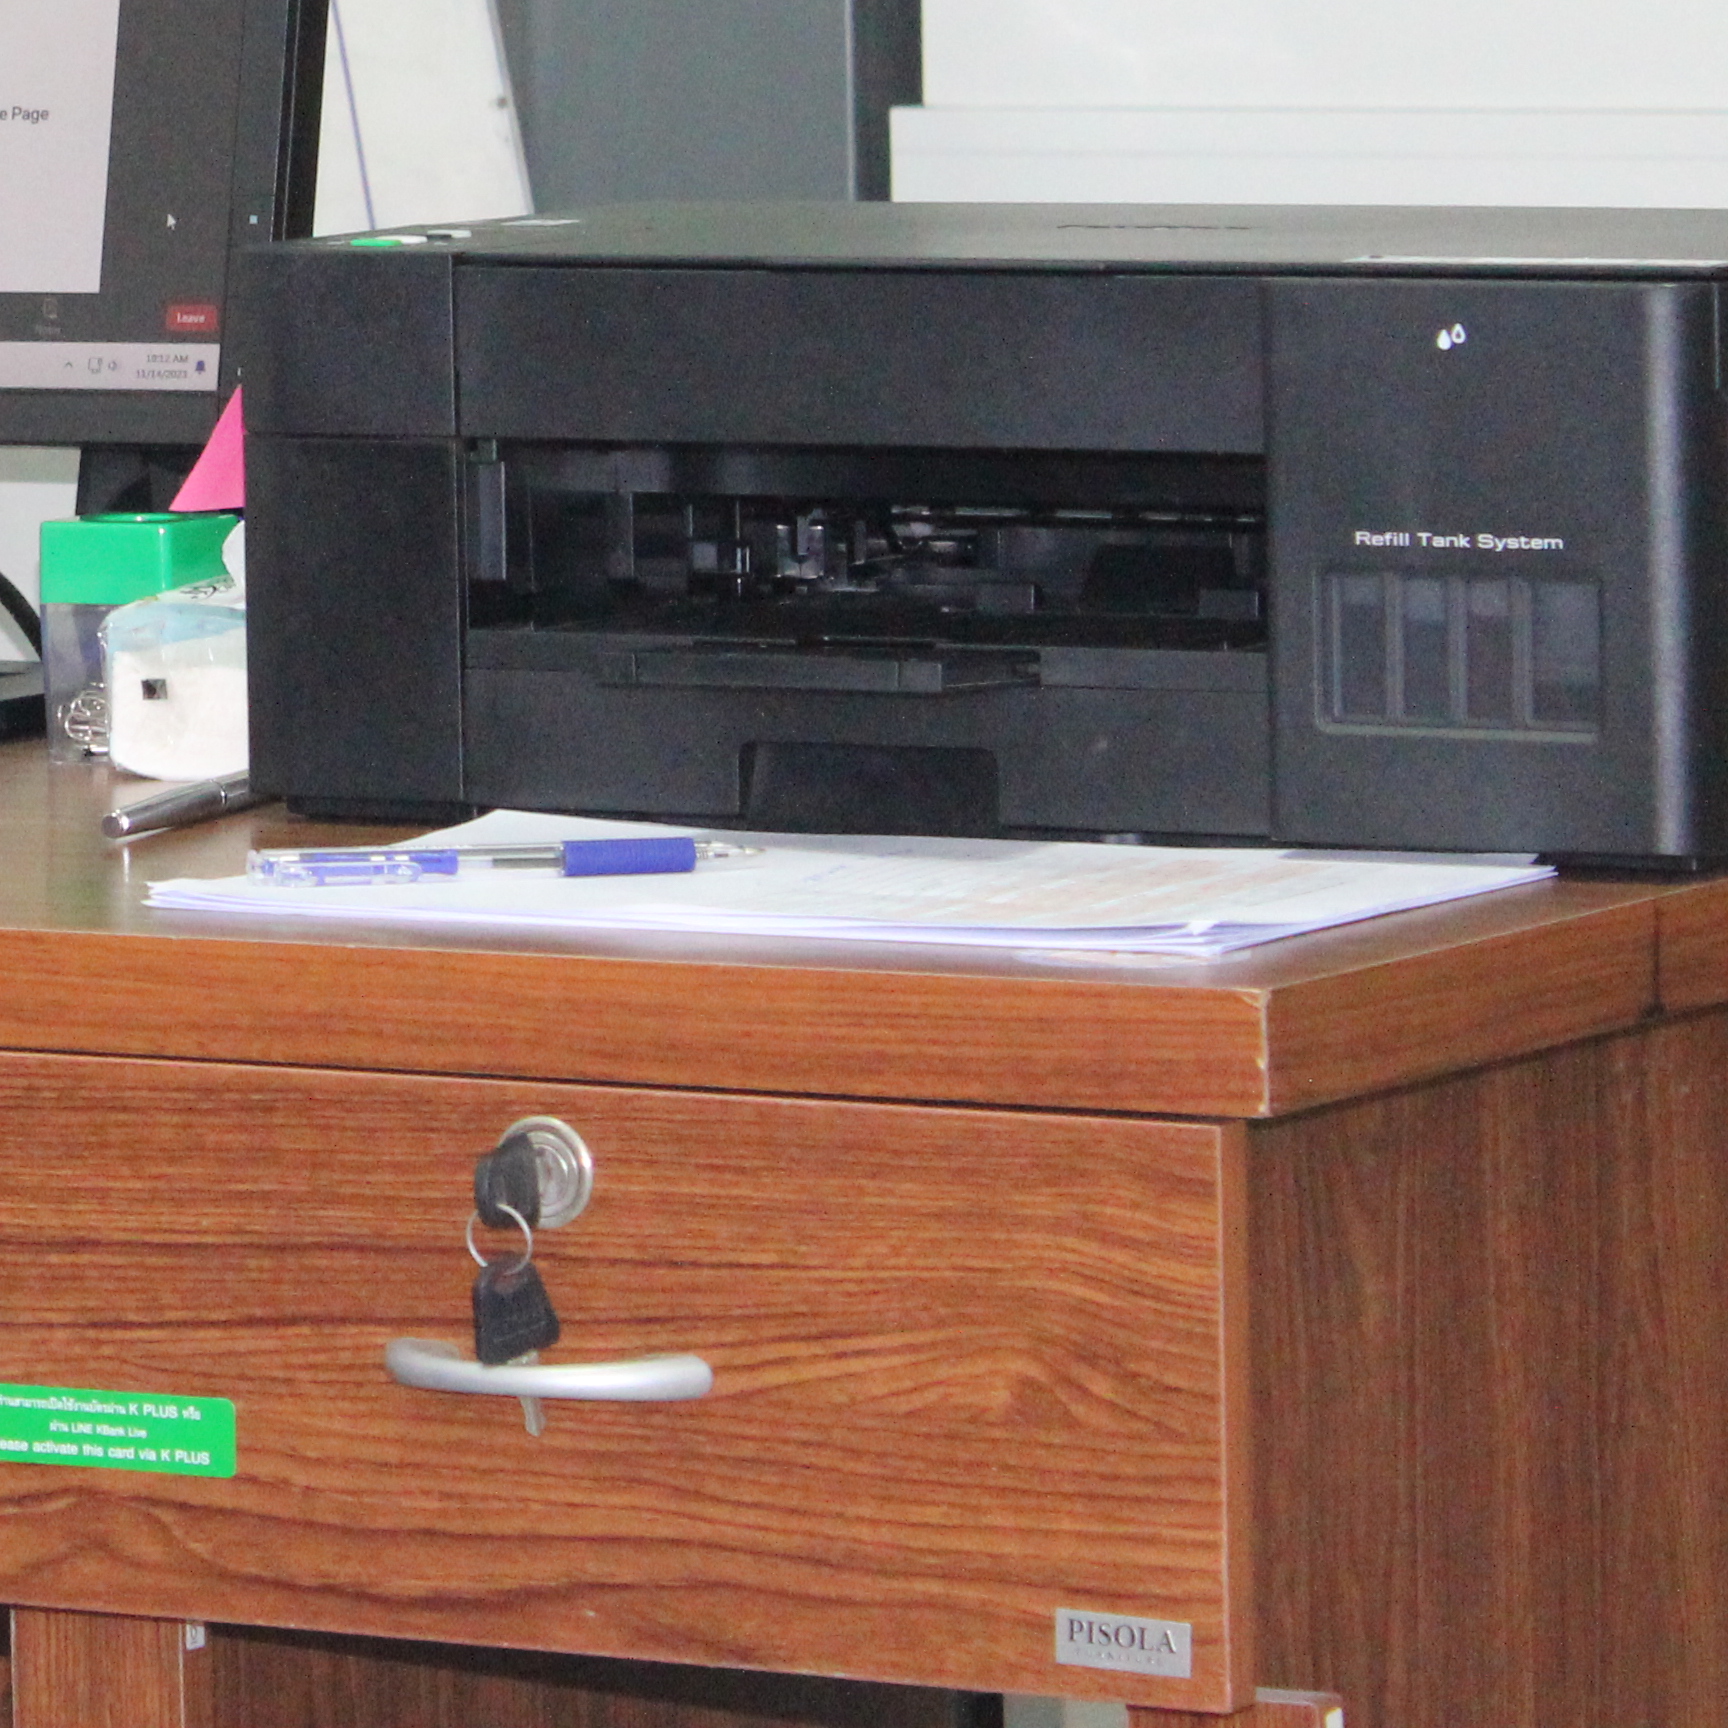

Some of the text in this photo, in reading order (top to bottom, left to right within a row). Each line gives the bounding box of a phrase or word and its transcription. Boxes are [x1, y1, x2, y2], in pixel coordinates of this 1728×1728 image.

[11, 106, 49, 123] Page
[1355, 530, 1564, 552] Refill Tank System
[129, 1403, 139, 1416] K
[143, 1403, 179, 1419] PLUS
[33, 1440, 78, 1456] activate
[82, 1443, 104, 1457] this
[108, 1446, 135, 1460] card
[139, 1448, 157, 1461] via
[161, 1449, 171, 1462] K
[175, 1450, 210, 1465] PLUS
[1068, 1618, 1177, 1654] PISOLA
